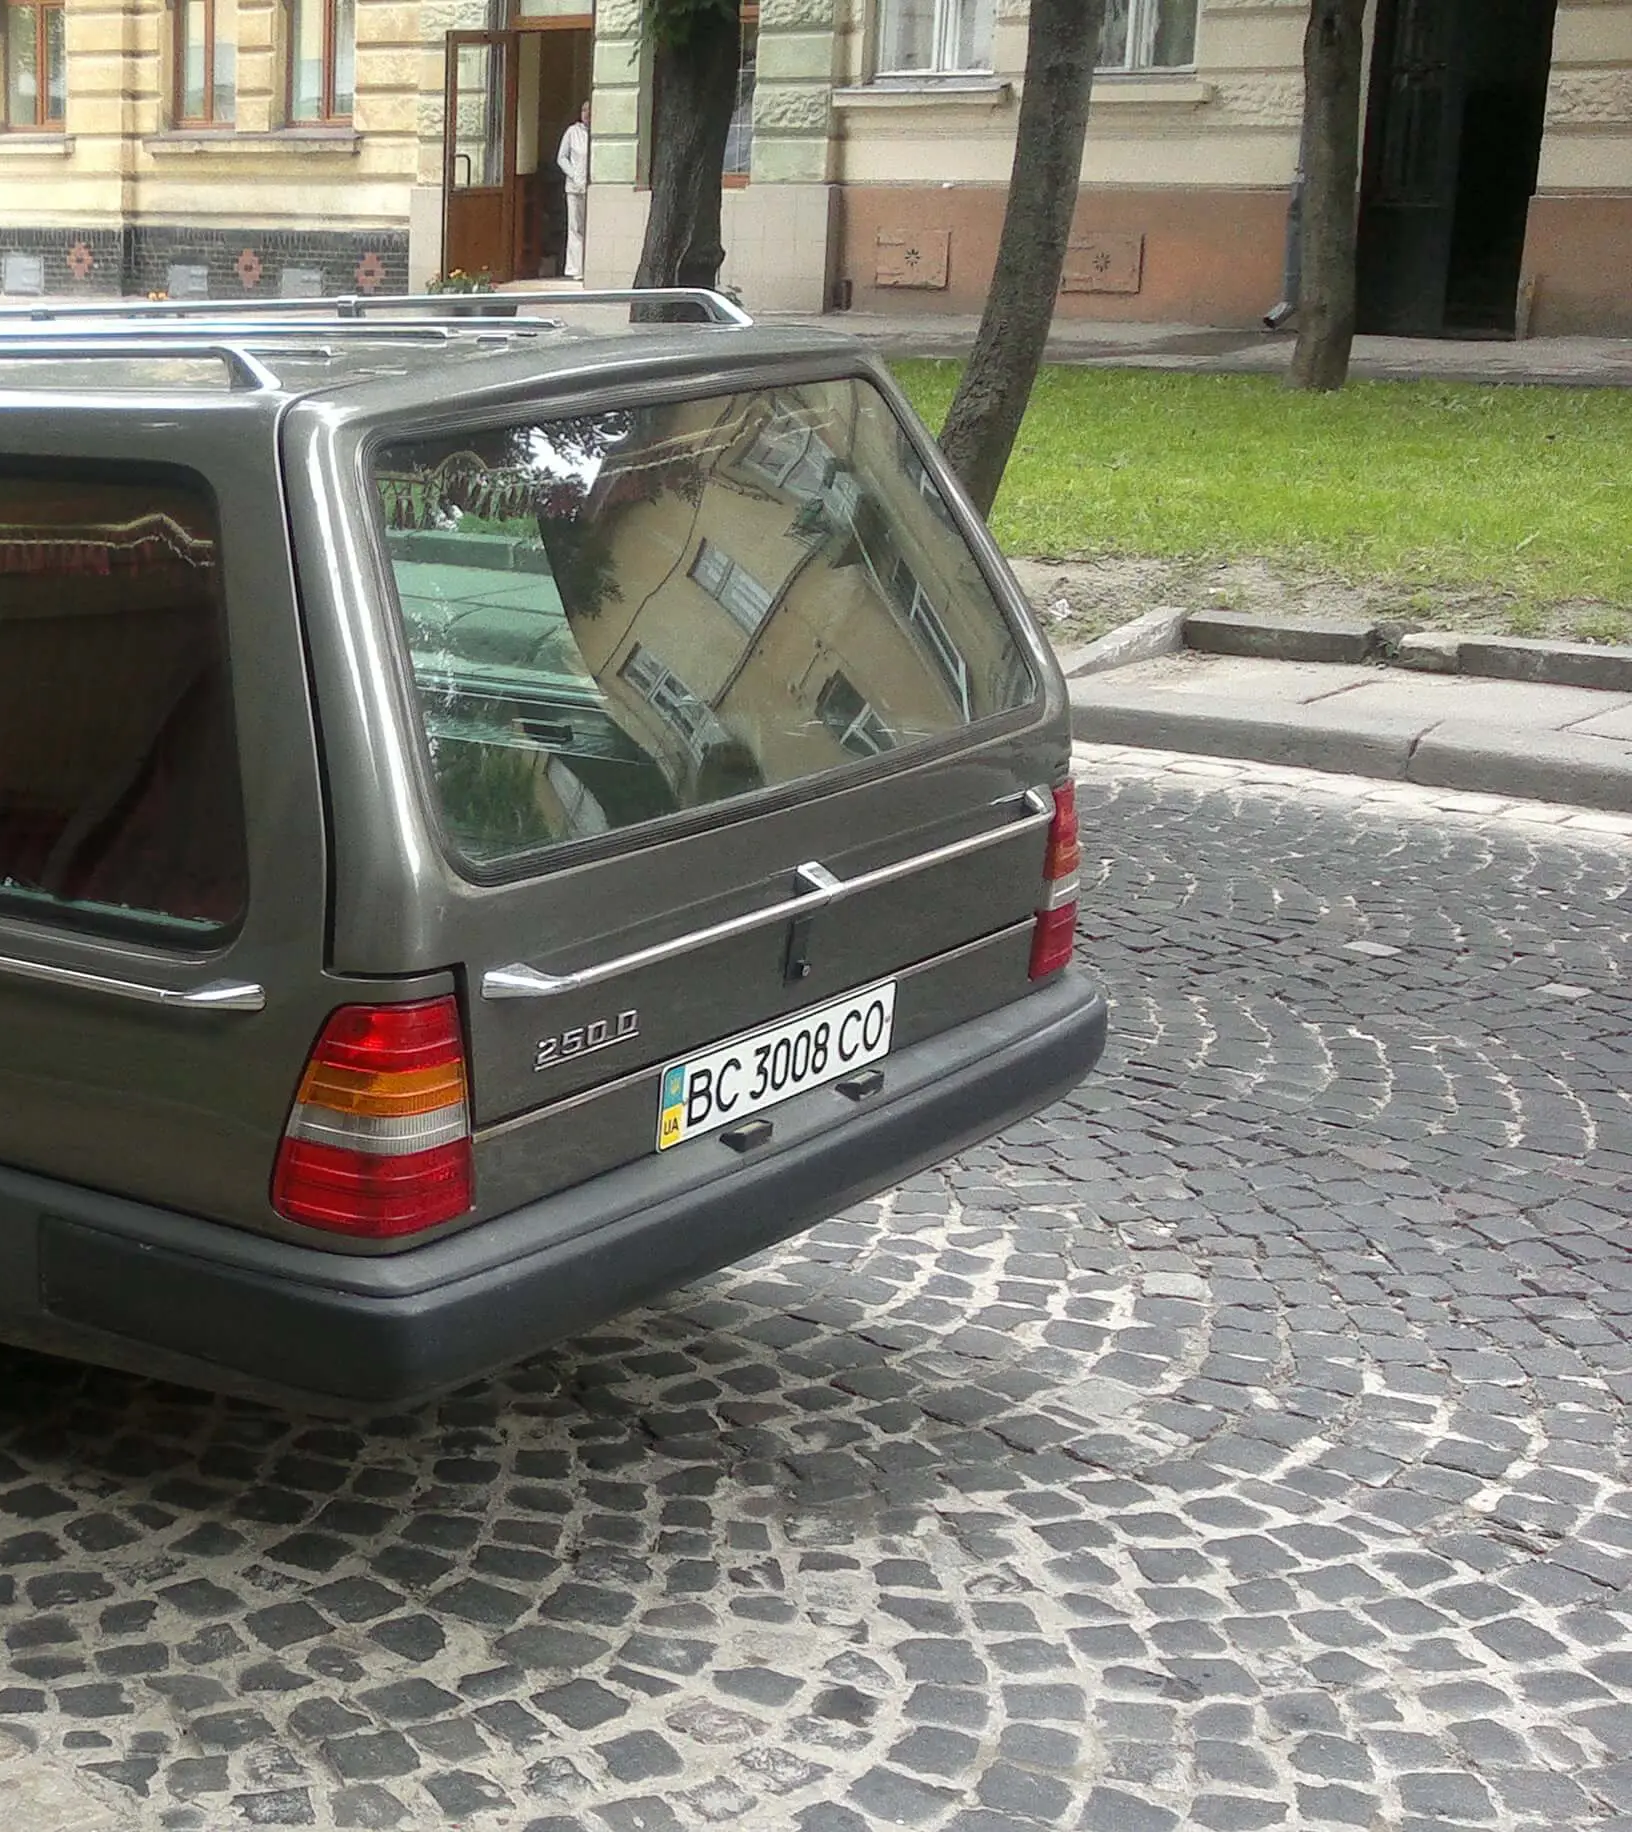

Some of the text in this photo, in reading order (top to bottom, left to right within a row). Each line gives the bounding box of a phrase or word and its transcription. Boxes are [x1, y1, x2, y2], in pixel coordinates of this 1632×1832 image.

[536, 1019, 607, 1065] 250
[686, 999, 885, 1128] BC 3008 CO
[663, 1116, 680, 1136] UA
